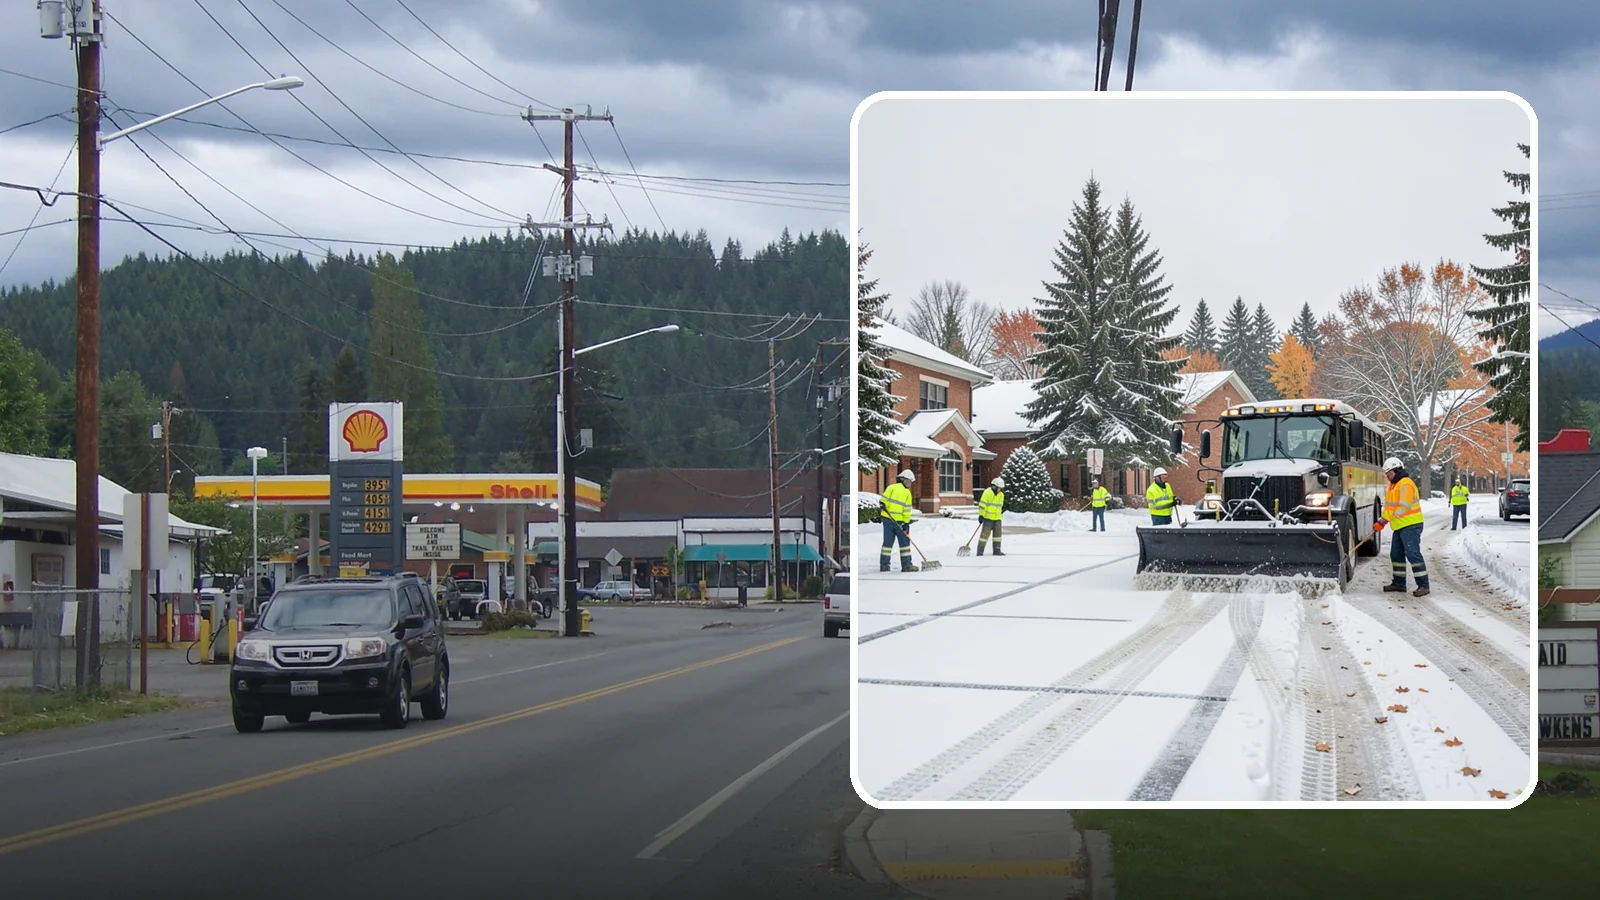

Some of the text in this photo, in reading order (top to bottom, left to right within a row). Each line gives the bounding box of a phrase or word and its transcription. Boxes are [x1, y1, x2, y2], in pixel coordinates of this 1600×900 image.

[366, 480, 383, 490] 395
[489, 484, 547, 499] Shell
[365, 494, 383, 504] 405
[365, 508, 383, 518] 415
[366, 522, 383, 533] 429
